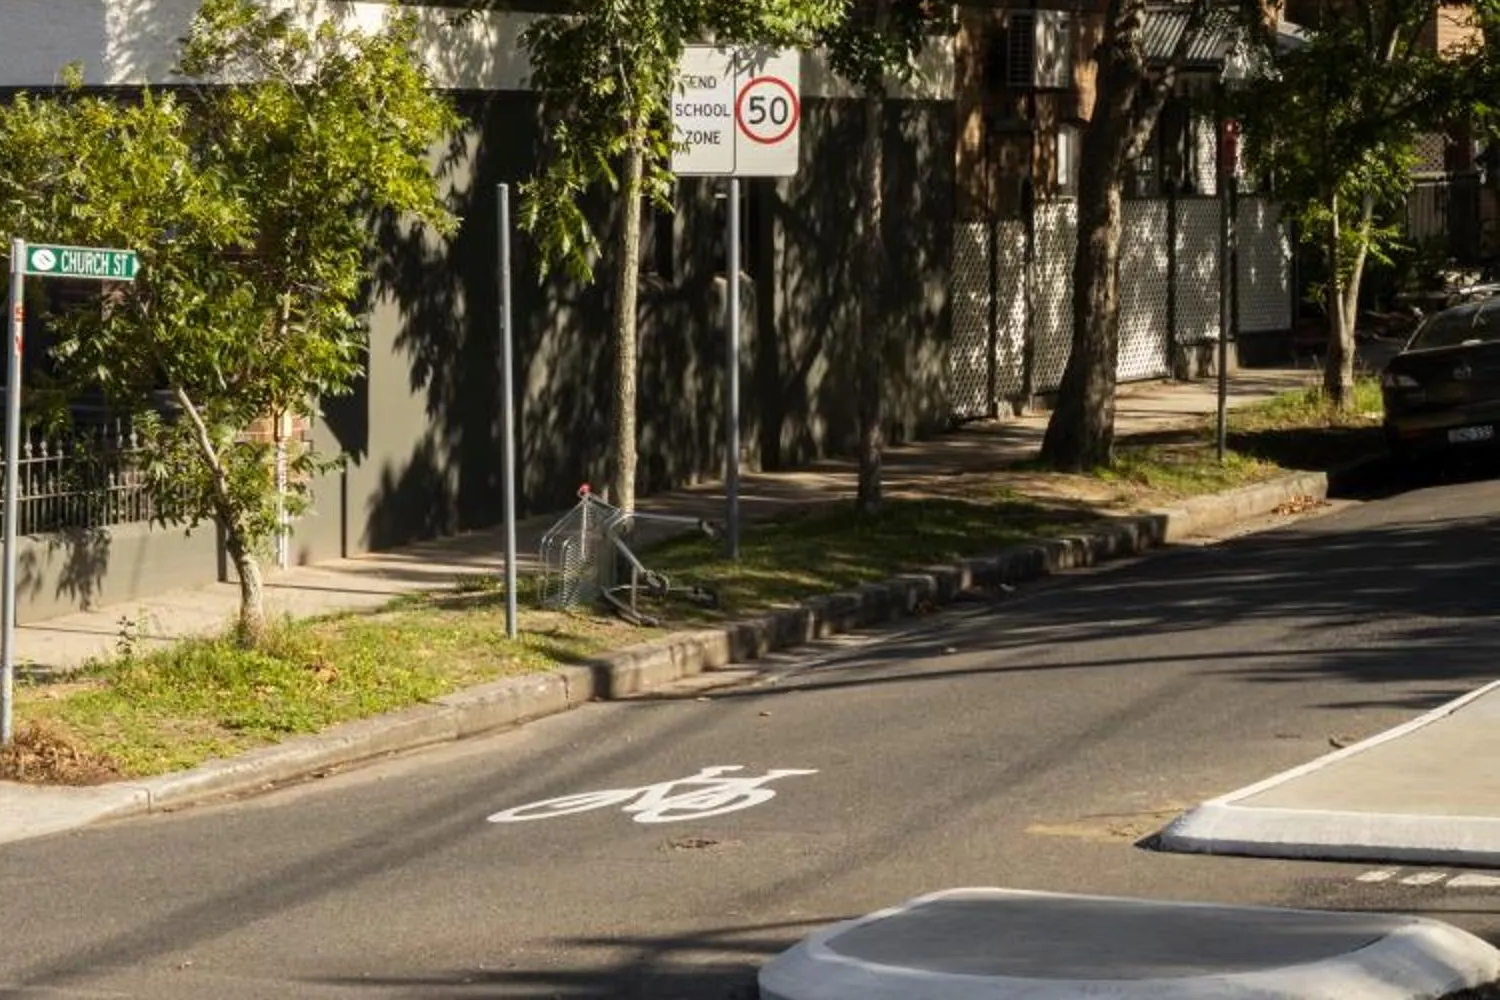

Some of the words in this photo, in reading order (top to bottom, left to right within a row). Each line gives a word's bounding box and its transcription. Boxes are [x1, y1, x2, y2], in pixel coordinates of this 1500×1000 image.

[689, 75, 717, 89] END
[675, 103, 731, 117] SCHOOL
[748, 95, 789, 126] 50
[685, 130, 721, 145] ZONE
[61, 251, 109, 275] CHURCH
[113, 255, 129, 275] ST
